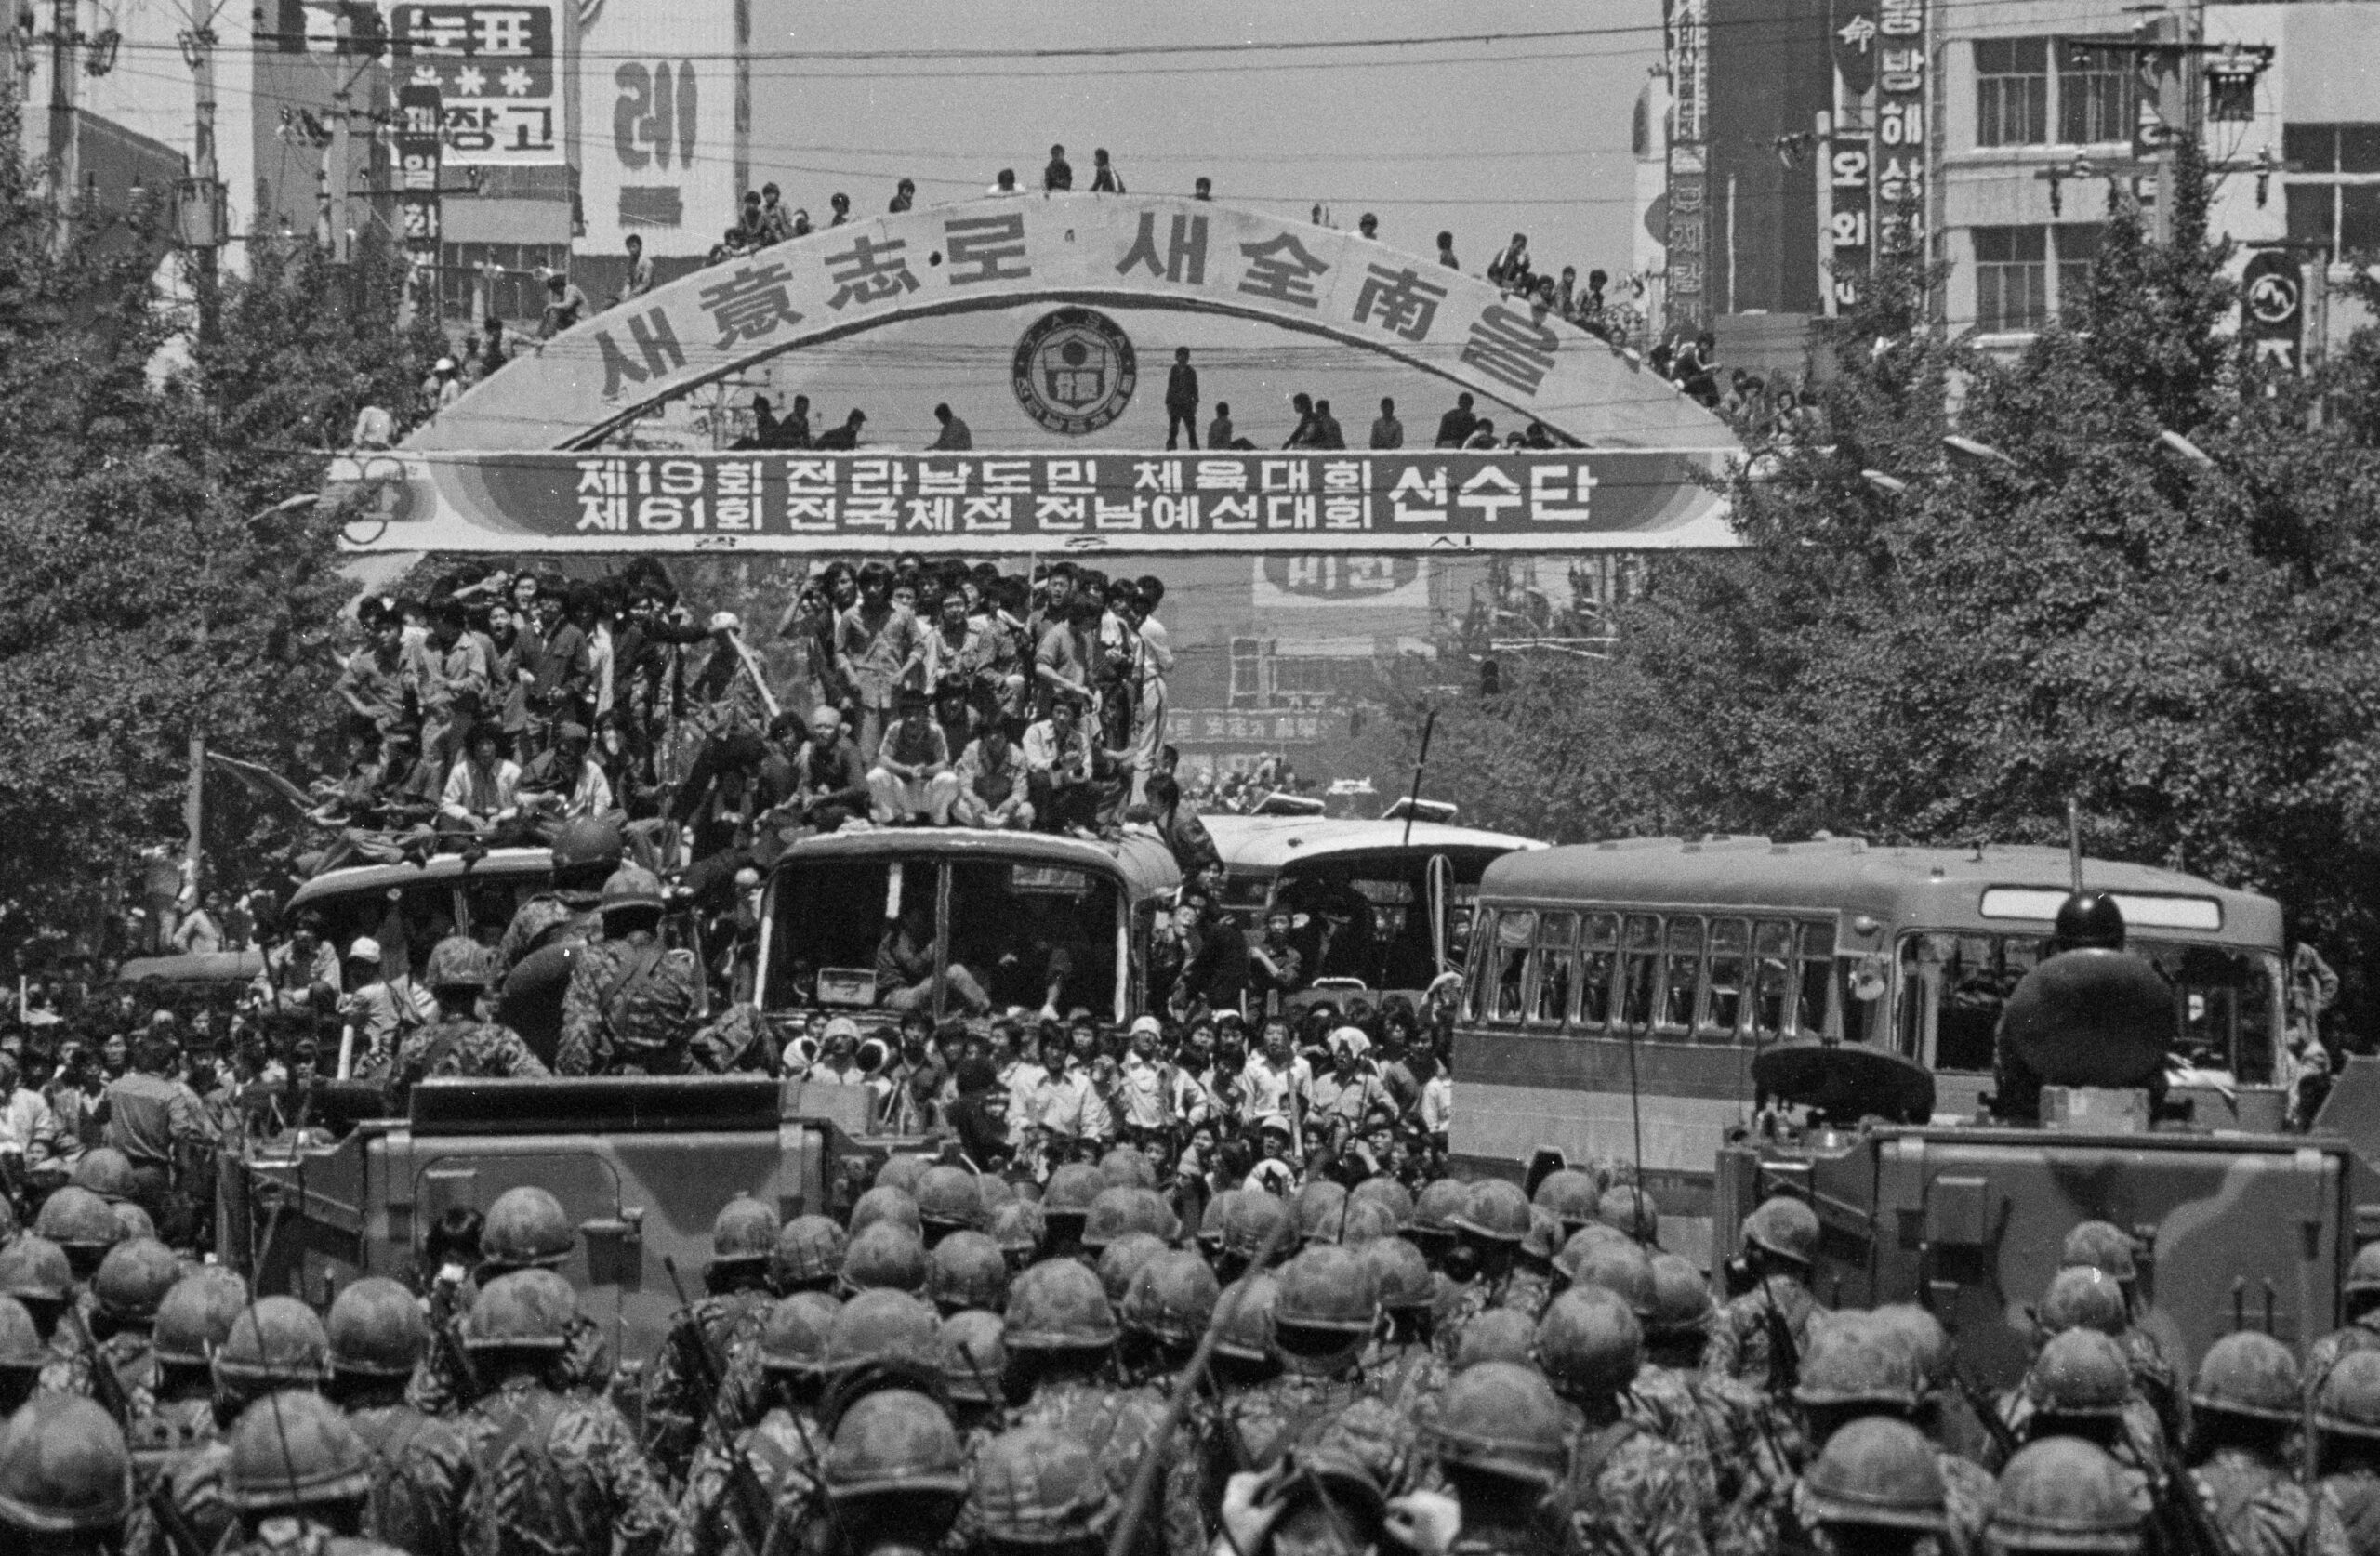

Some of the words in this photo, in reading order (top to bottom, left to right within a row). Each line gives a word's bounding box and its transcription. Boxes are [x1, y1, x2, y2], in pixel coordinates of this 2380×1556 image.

[444, 106, 555, 152] 장고
[577, 460, 762, 495] 제19회
[787, 460, 1097, 495] 전라남도민
[1134, 459, 1372, 494] 체육대회
[1388, 465, 1598, 522] 선수단
[576, 496, 763, 533] 제61회
[787, 495, 1012, 532] 전국체전
[1036, 494, 1372, 531] 전남예선대회
